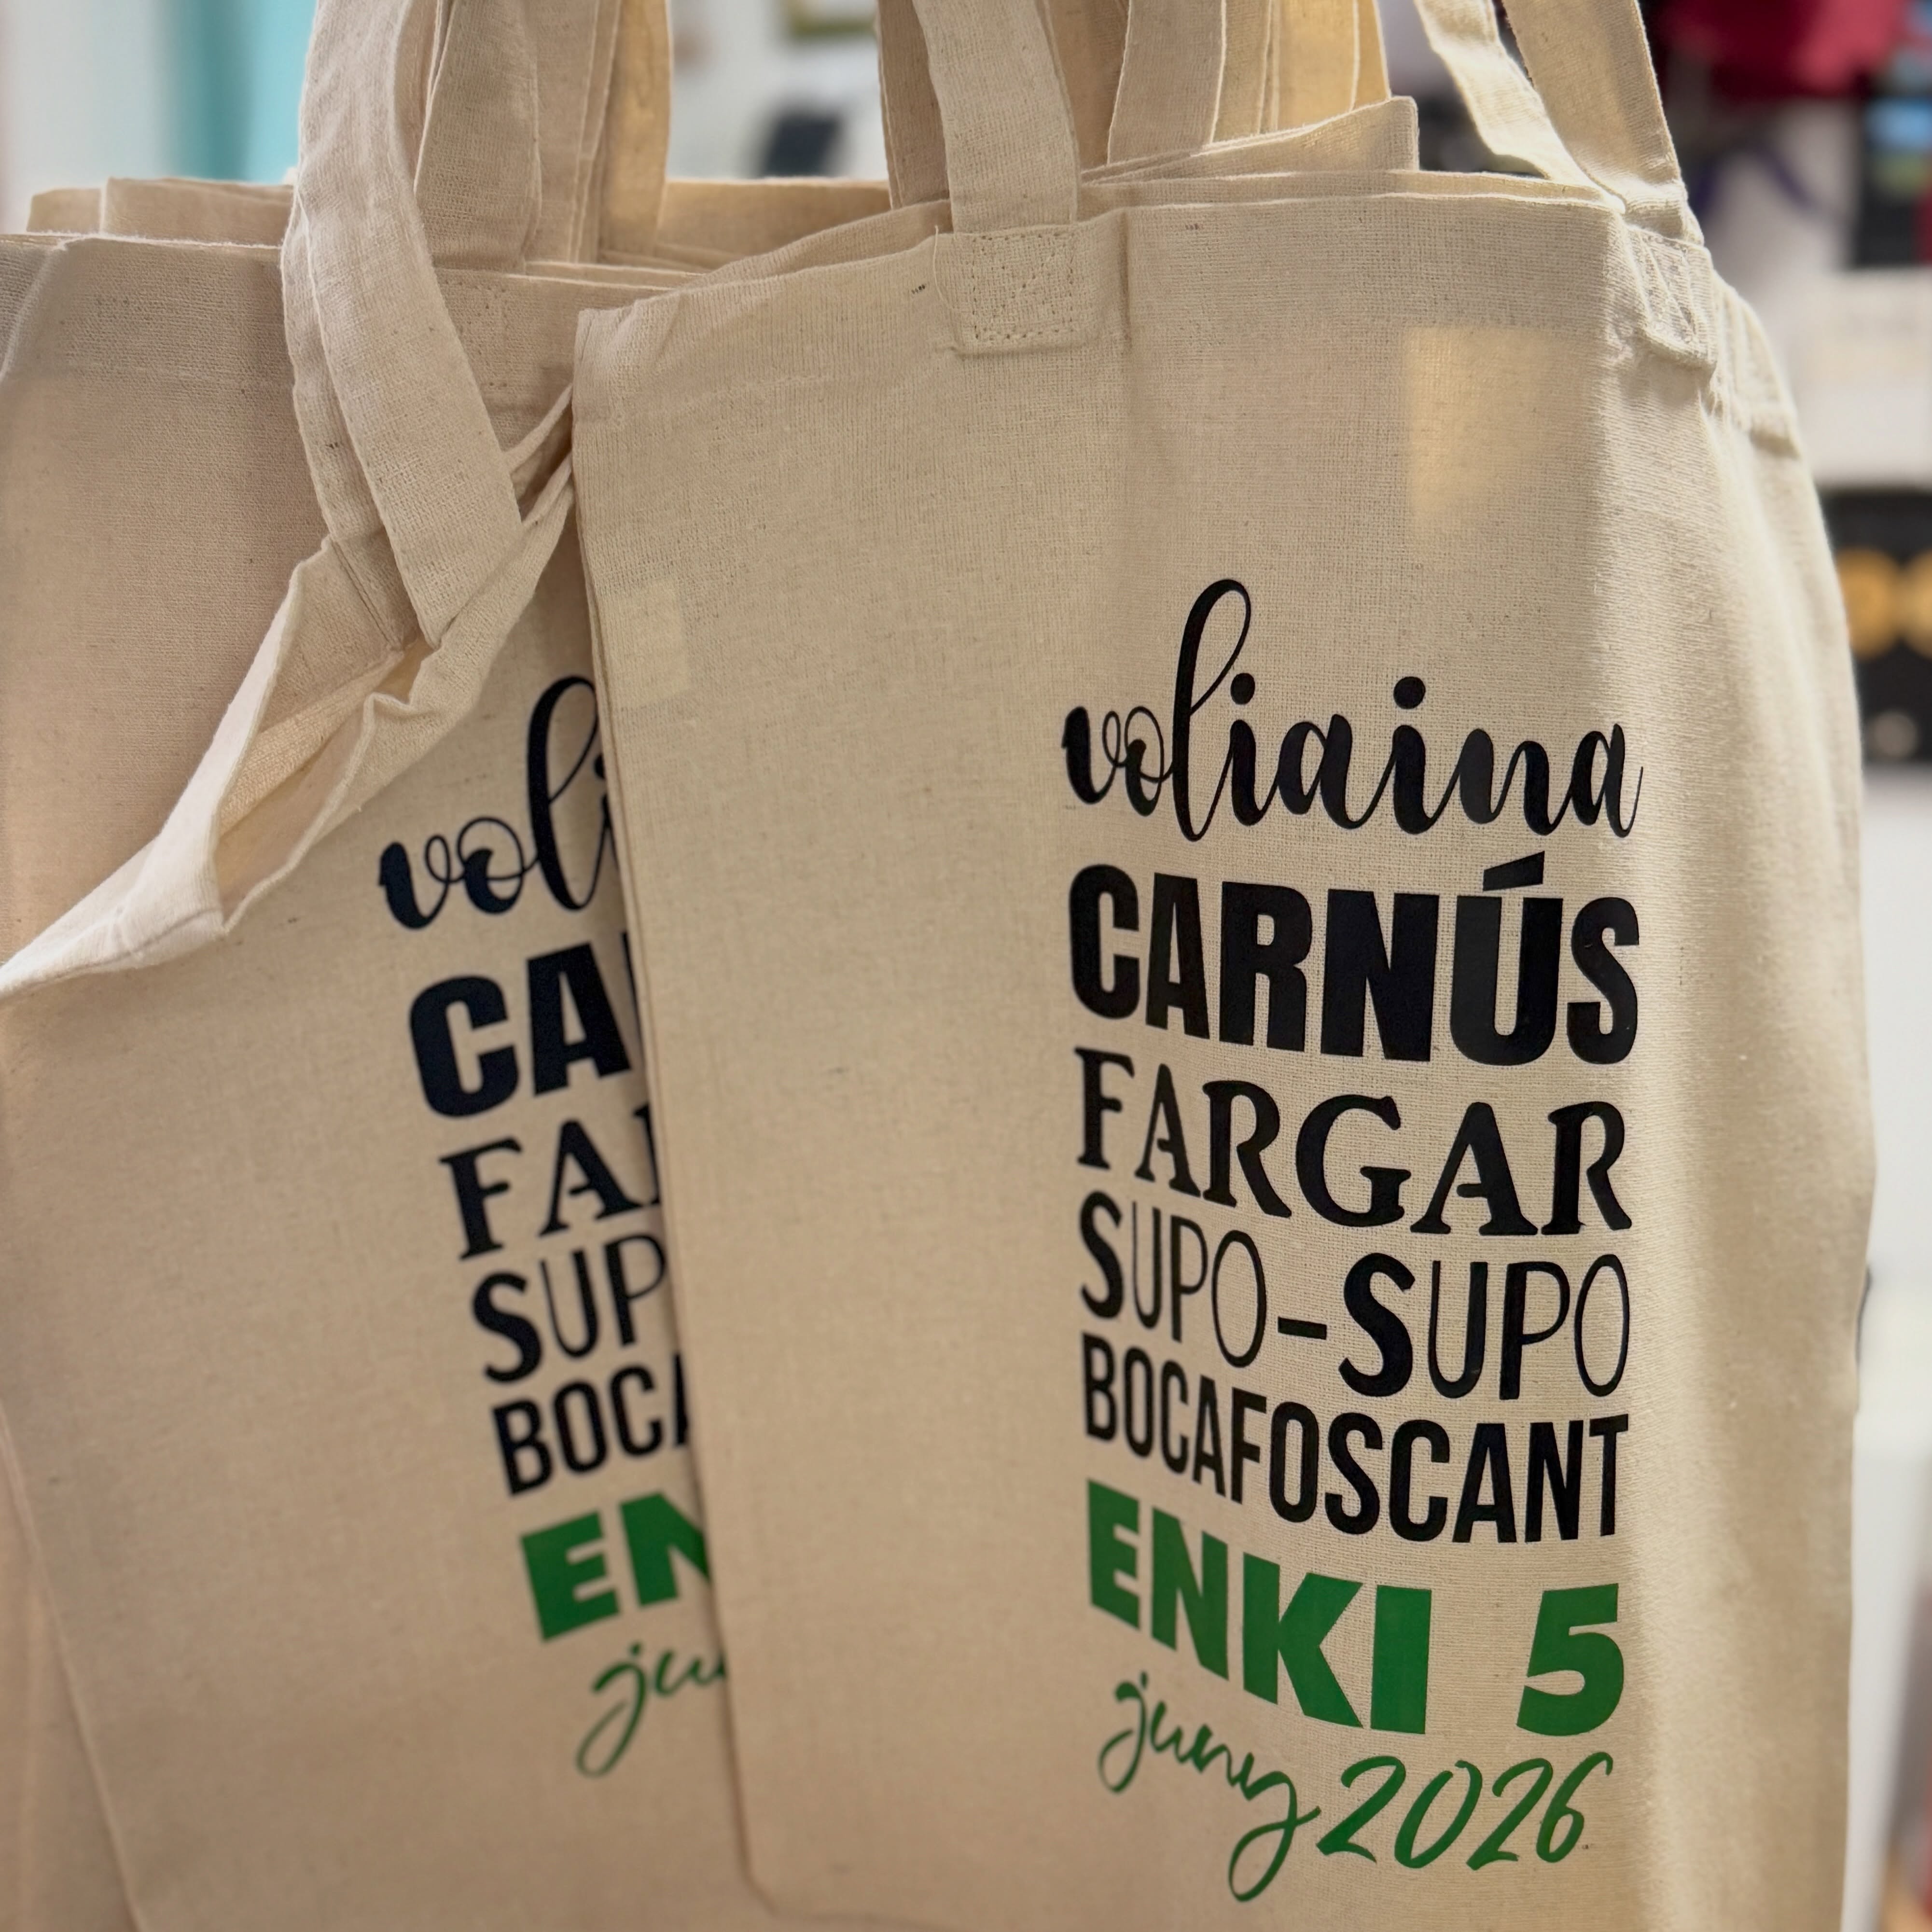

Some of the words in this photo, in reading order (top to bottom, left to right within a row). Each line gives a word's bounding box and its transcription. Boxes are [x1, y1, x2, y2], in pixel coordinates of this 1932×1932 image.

[1062, 578, 1643, 842] voliaina
[409, 931, 642, 1118] CA
[1069, 851, 1640, 1066] CARNÚS
[1074, 1047, 1632, 1236] FARGAR
[1080, 1191, 1630, 1401] SUPO-SUPO
[1083, 1334, 1628, 1543] BOCAFOSCANT
[1088, 1482, 1432, 1735] ENKI
[1517, 1583, 1624, 1737] 5
[1099, 1672, 1320, 1902] juny
[1317, 1752, 1613, 1871] 2026
